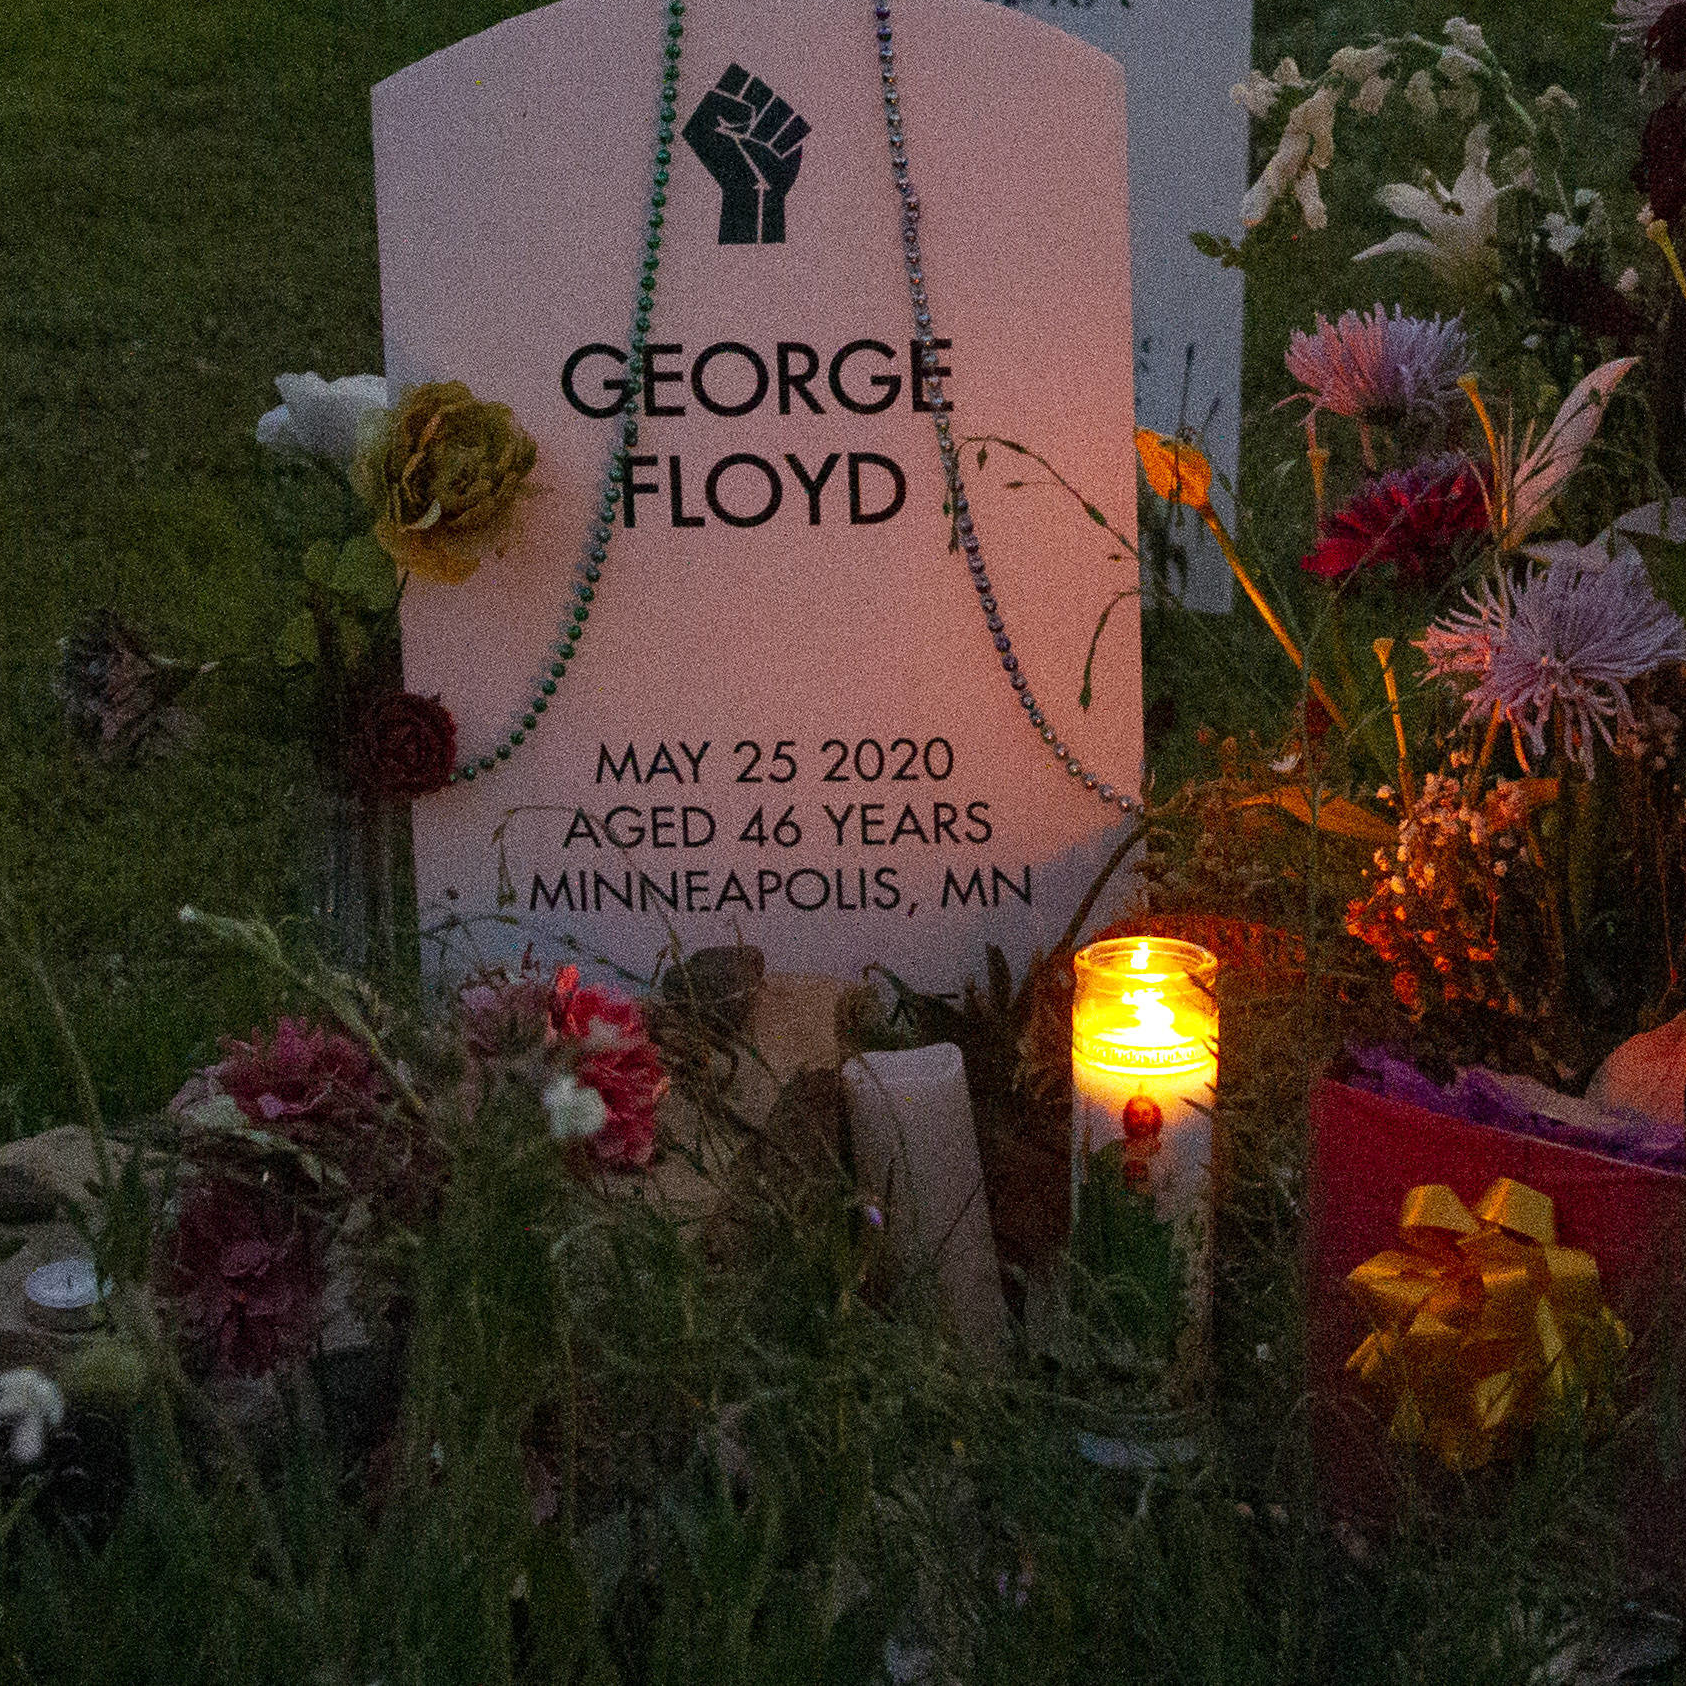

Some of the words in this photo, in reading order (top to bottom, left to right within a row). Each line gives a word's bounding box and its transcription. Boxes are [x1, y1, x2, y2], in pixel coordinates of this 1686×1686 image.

[561, 339, 954, 418] GEORGE
[622, 452, 907, 528] FLOYD
[596, 741, 711, 783] MAY
[734, 740, 797, 783] 25
[822, 738, 954, 782] 2020
[563, 805, 715, 848] AGED
[739, 804, 802, 847] 46
[823, 801, 992, 845] YEARS
[530, 867, 919, 916] MINNEAPOLIS,
[941, 865, 1034, 907] MN
